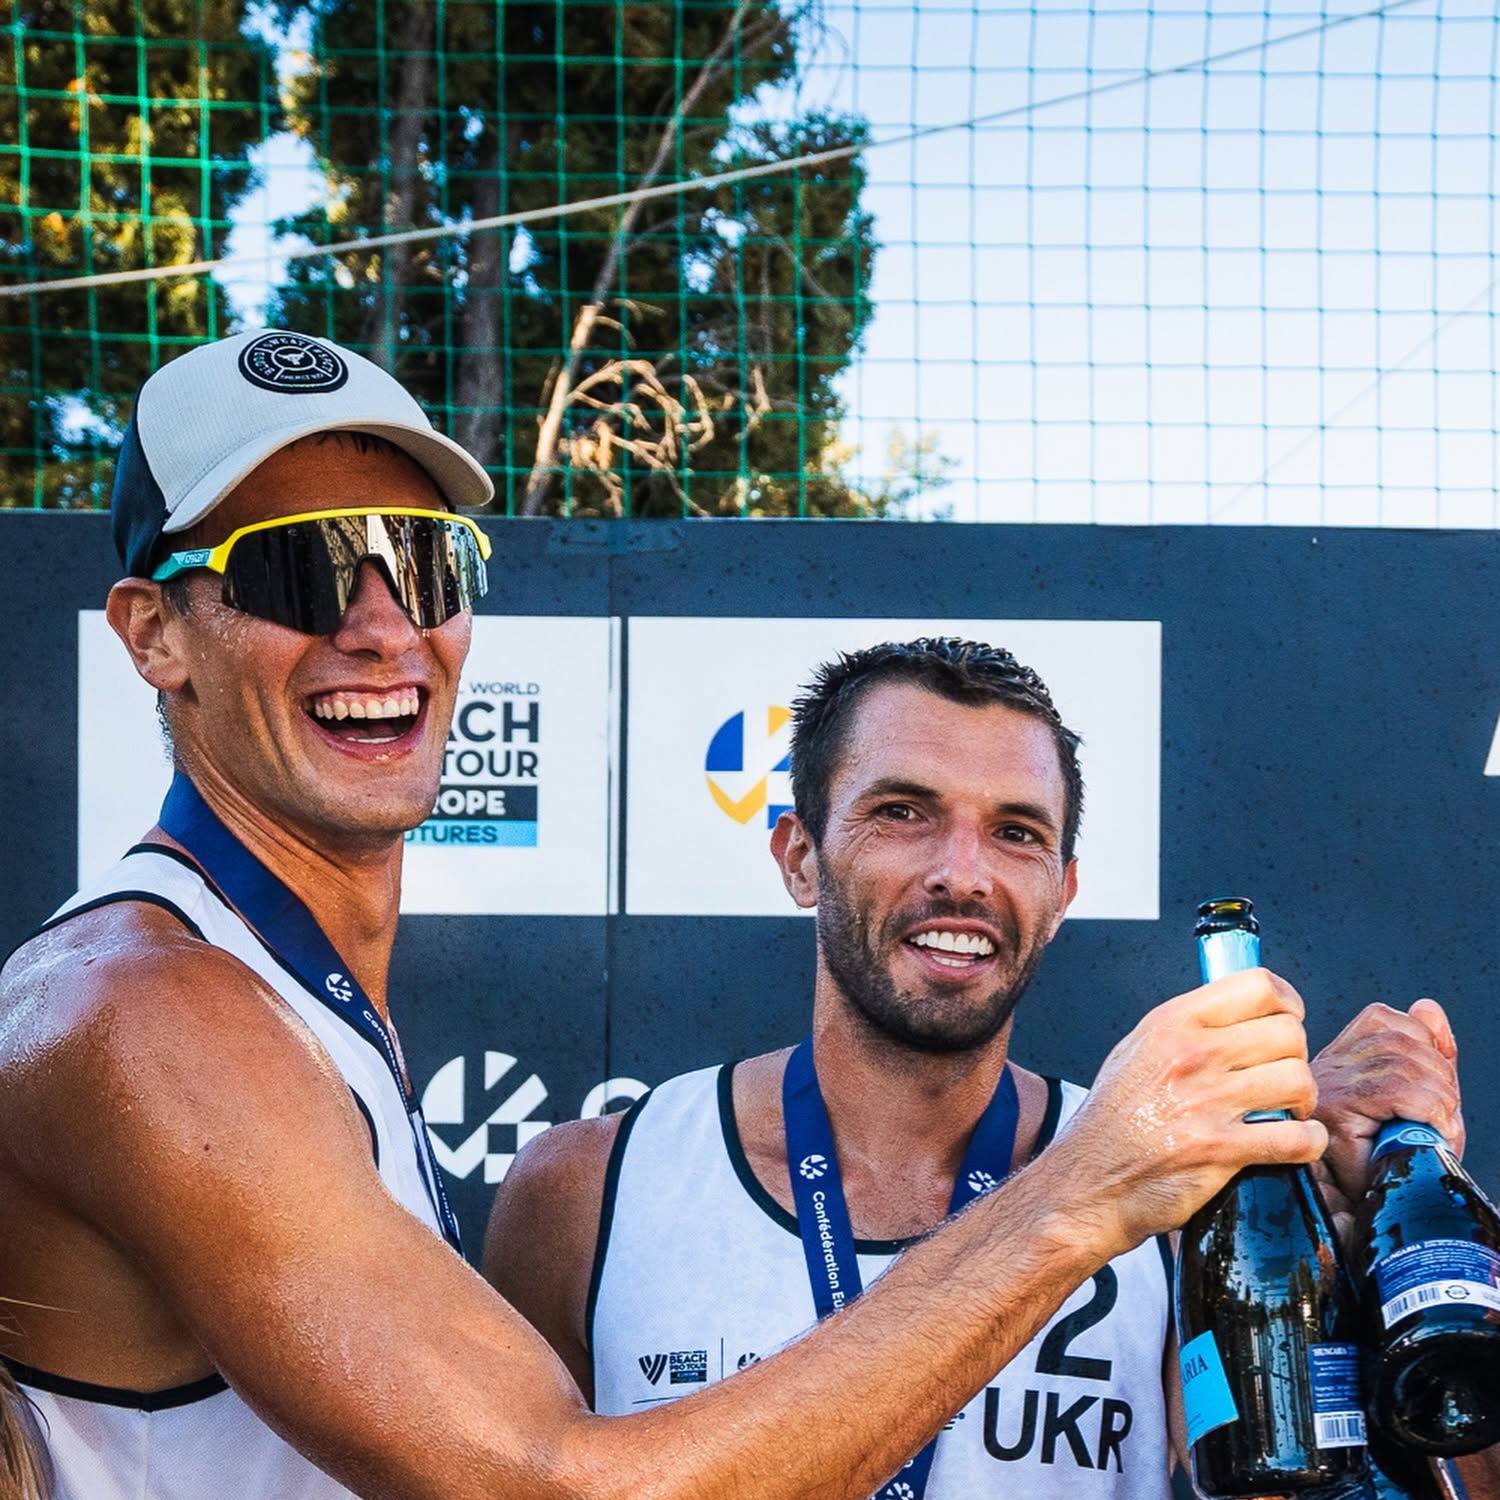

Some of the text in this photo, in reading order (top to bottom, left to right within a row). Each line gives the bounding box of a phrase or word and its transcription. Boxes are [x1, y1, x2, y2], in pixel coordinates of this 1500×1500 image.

[470, 682, 540, 695] WORLD
[812, 1191, 840, 1289] Confédération
[669, 1353, 708, 1365] BEACH
[1035, 1263, 1119, 1382] 2
[984, 1387, 1134, 1474] UKR
